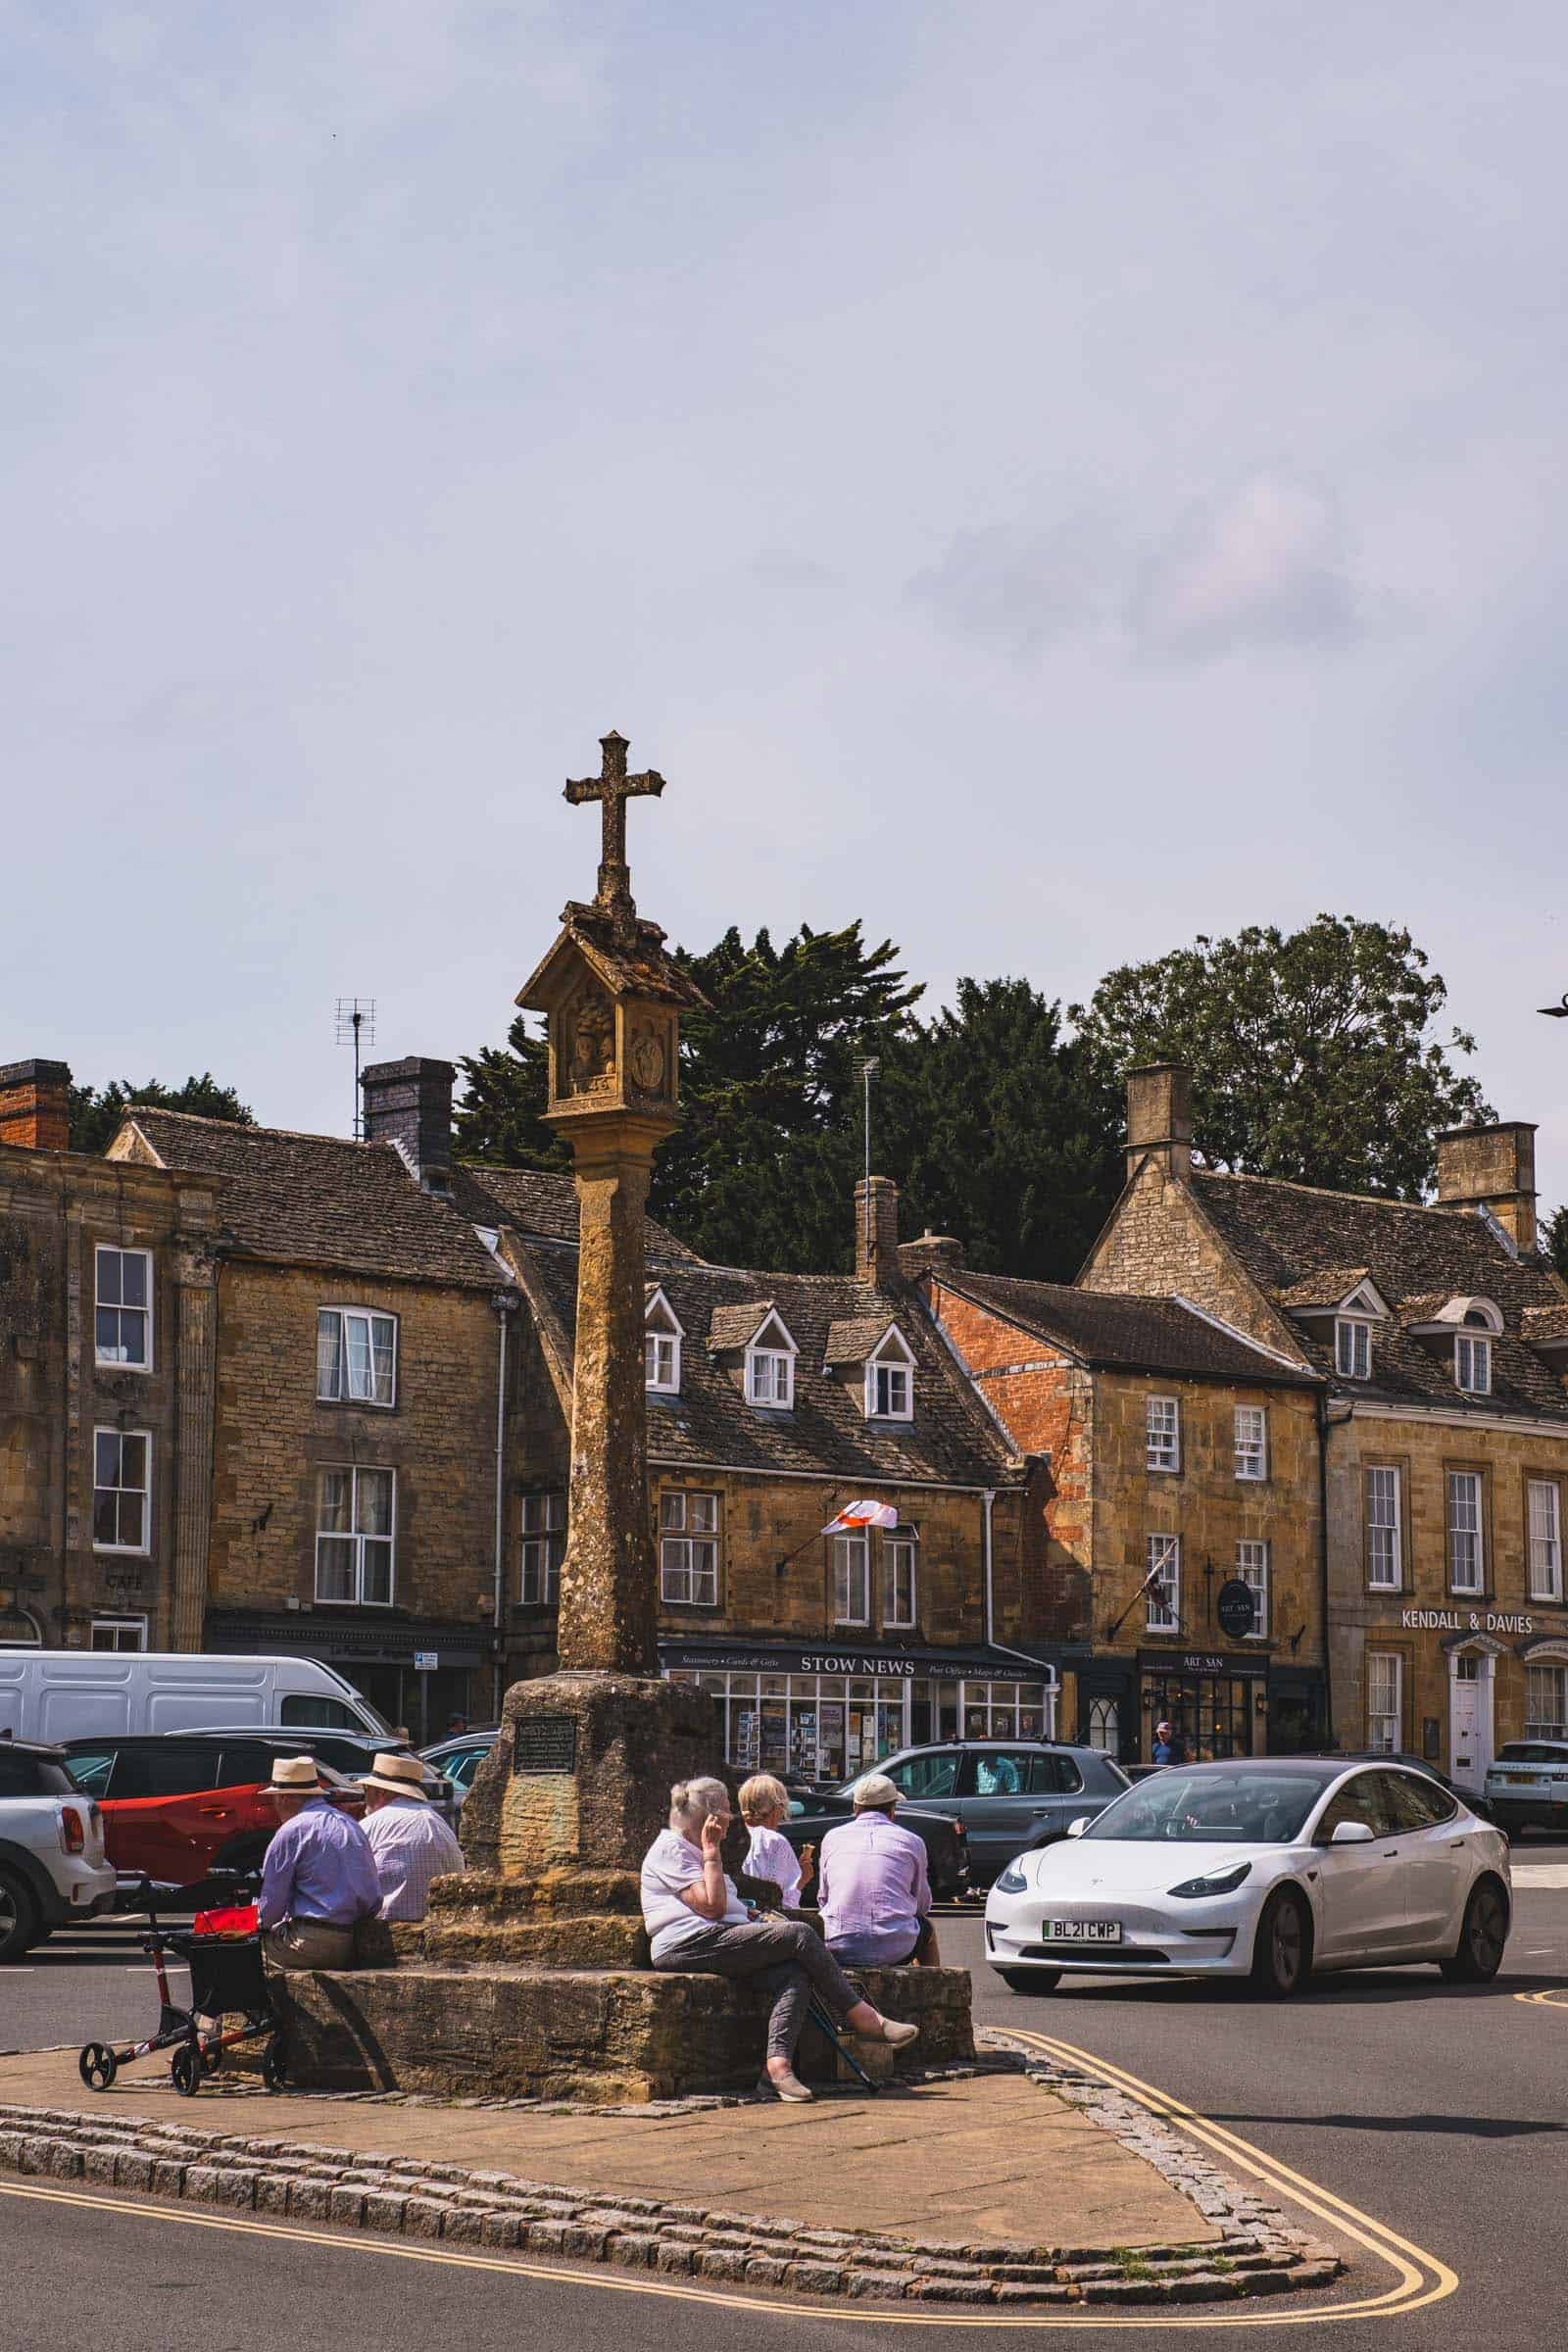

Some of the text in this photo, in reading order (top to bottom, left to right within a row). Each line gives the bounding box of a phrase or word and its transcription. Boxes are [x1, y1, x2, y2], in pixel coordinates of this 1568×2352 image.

[1402, 1610, 1533, 1634] KENDALL & DAVIES
[801, 1656, 915, 1675] STOW NEWS
[1054, 1922, 1115, 1938] BL21 CWP
